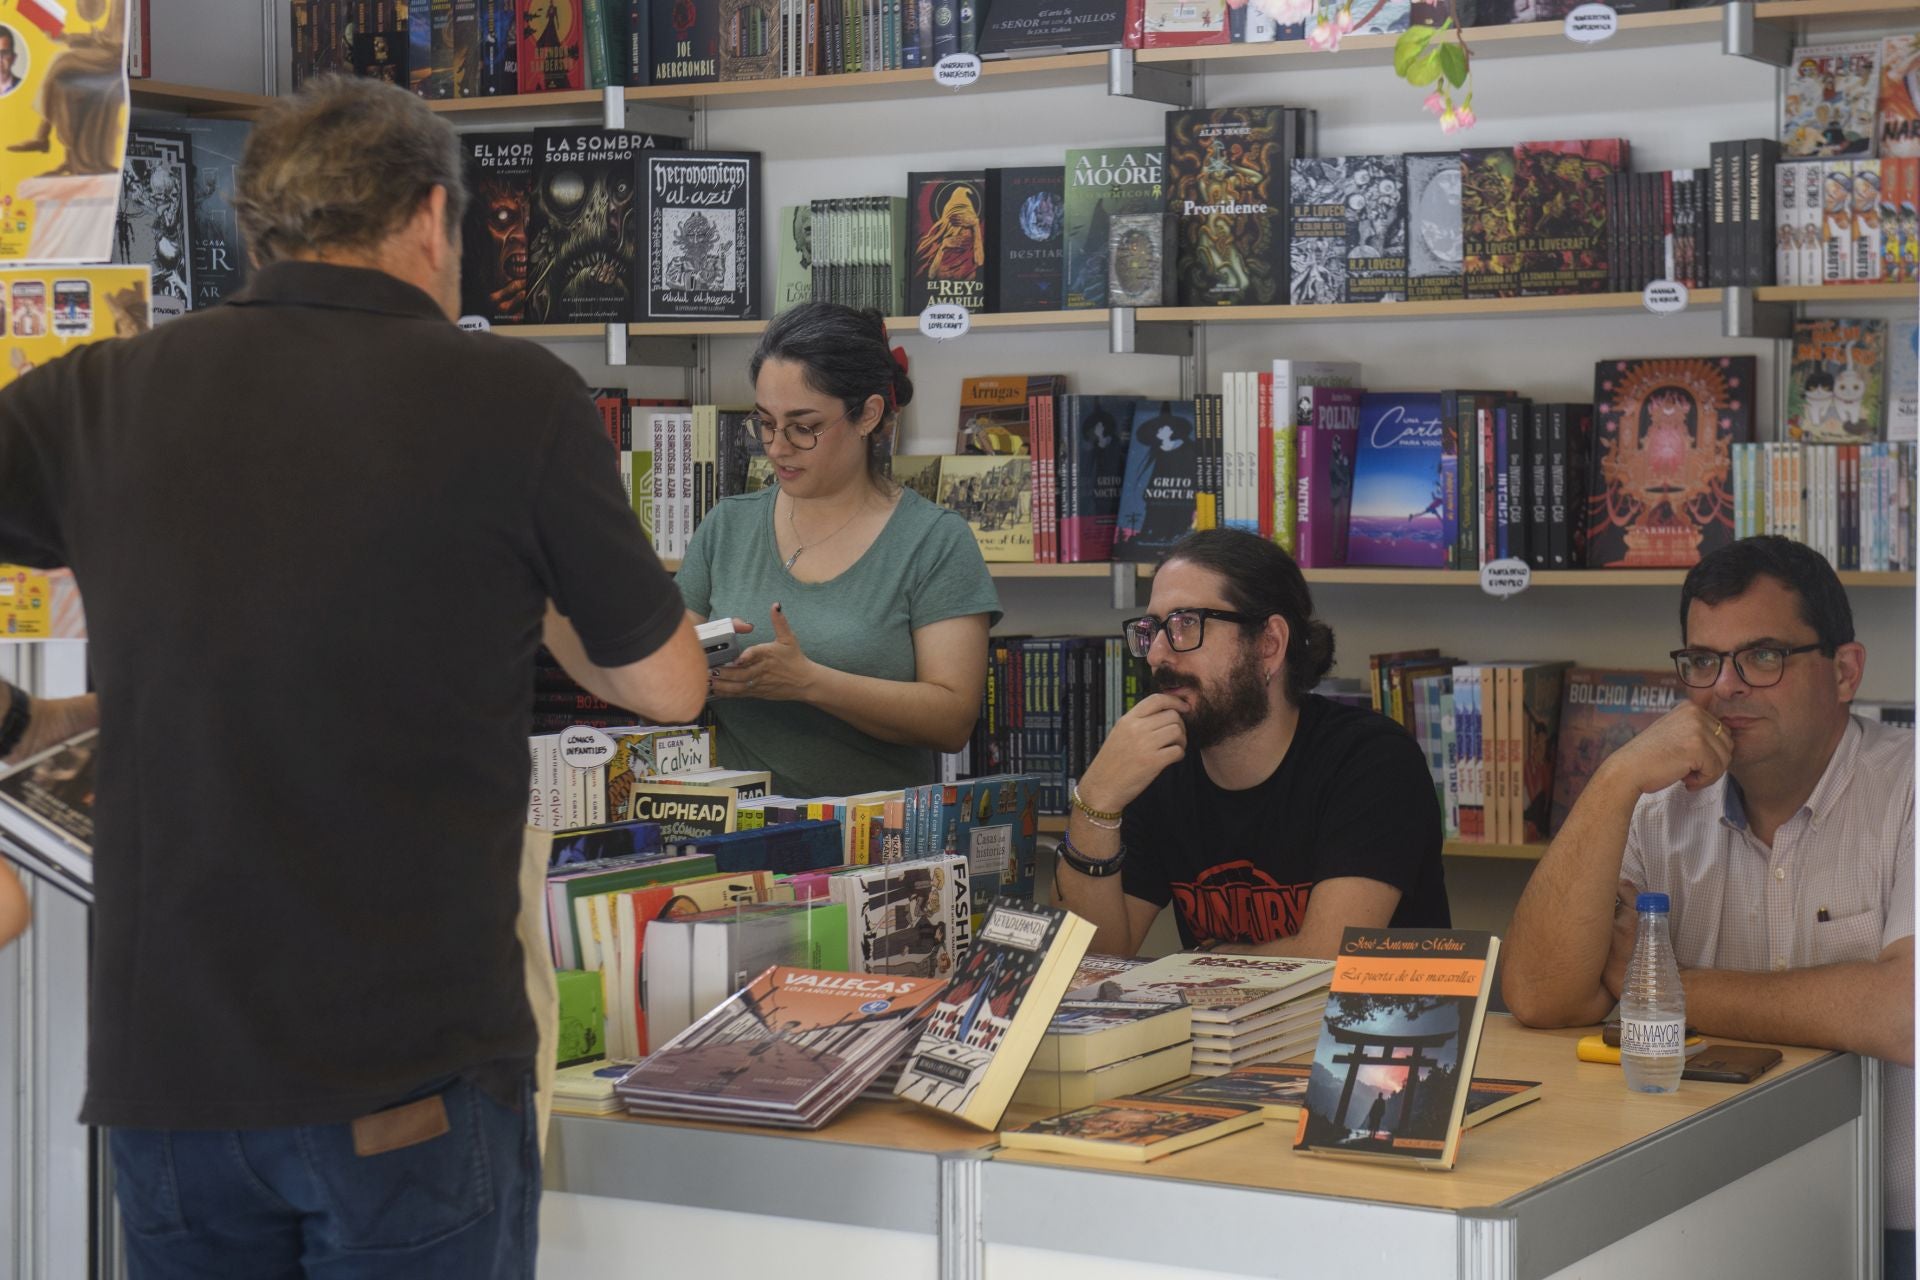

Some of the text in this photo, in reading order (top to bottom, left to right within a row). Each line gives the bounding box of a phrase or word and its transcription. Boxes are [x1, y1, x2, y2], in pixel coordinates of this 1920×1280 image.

[1001, 17, 1040, 30] SEÑOR
[1064, 12, 1117, 25] ANILLOS
[676, 41, 692, 57] JOE
[656, 59, 716, 79] ABERCROMBIE
[474, 144, 493, 157] EL
[546, 135, 655, 152] LA SOMBRA
[481, 157, 518, 167] DE LAS
[545, 152, 584, 163] SOBRE
[1075, 152, 1162, 169] ALAN
[1071, 165, 1162, 187] MOORE
[1714, 157, 1724, 223] BIBLIOMANIA
[1731, 156, 1741, 222] BIBLIOMANIA
[1749, 153, 1760, 221] BIBLIOMANIA
[1183, 199, 1268, 216] Providence
[1466, 244, 1483, 255] H.P.
[1519, 236, 1590, 251] H.P. LOVECRAFT
[1827, 236, 1839, 278] NARUTO
[1857, 235, 1869, 277] NARUTO
[927, 281, 939, 290] EL
[939, 280, 976, 295] REY
[970, 384, 1020, 401] Arrugas
[1402, 416, 1420, 425] UNA
[653, 420, 662, 498] LOS SURCOS DEL AZAR
[667, 420, 675, 498] LOS SURCOS DEL AZAR
[683, 420, 691, 498] LOS SURCOS DEL AZAR
[1153, 477, 1192, 488] GRITO
[1509, 465, 1521, 496] INVITADA
[1533, 465, 1545, 496] INVITADA
[1552, 465, 1564, 496] INVITADA
[1031, 461, 1039, 534] THE BLACK HOLES
[1145, 488, 1194, 500] NOCTUR
[1299, 477, 1310, 522] POLINA
[1498, 473, 1508, 527] INTENSA
[1635, 525, 1691, 535] CARMILLA
[1569, 683, 1676, 707] BOLCHOI ARENA
[566, 745, 607, 756] INFANTILES
[666, 739, 684, 749] GRAN
[635, 796, 726, 822] CUPHEAD
[906, 797, 914, 821] Casas
[932, 793, 941, 817] Casas
[976, 833, 997, 846] Casas
[1345, 935, 1466, 952] José Antonio Molina
[785, 973, 916, 994] VALLECAS
[1340, 967, 1477, 985] La puerta de las maravillas
[849, 990, 888, 999] BARRO
